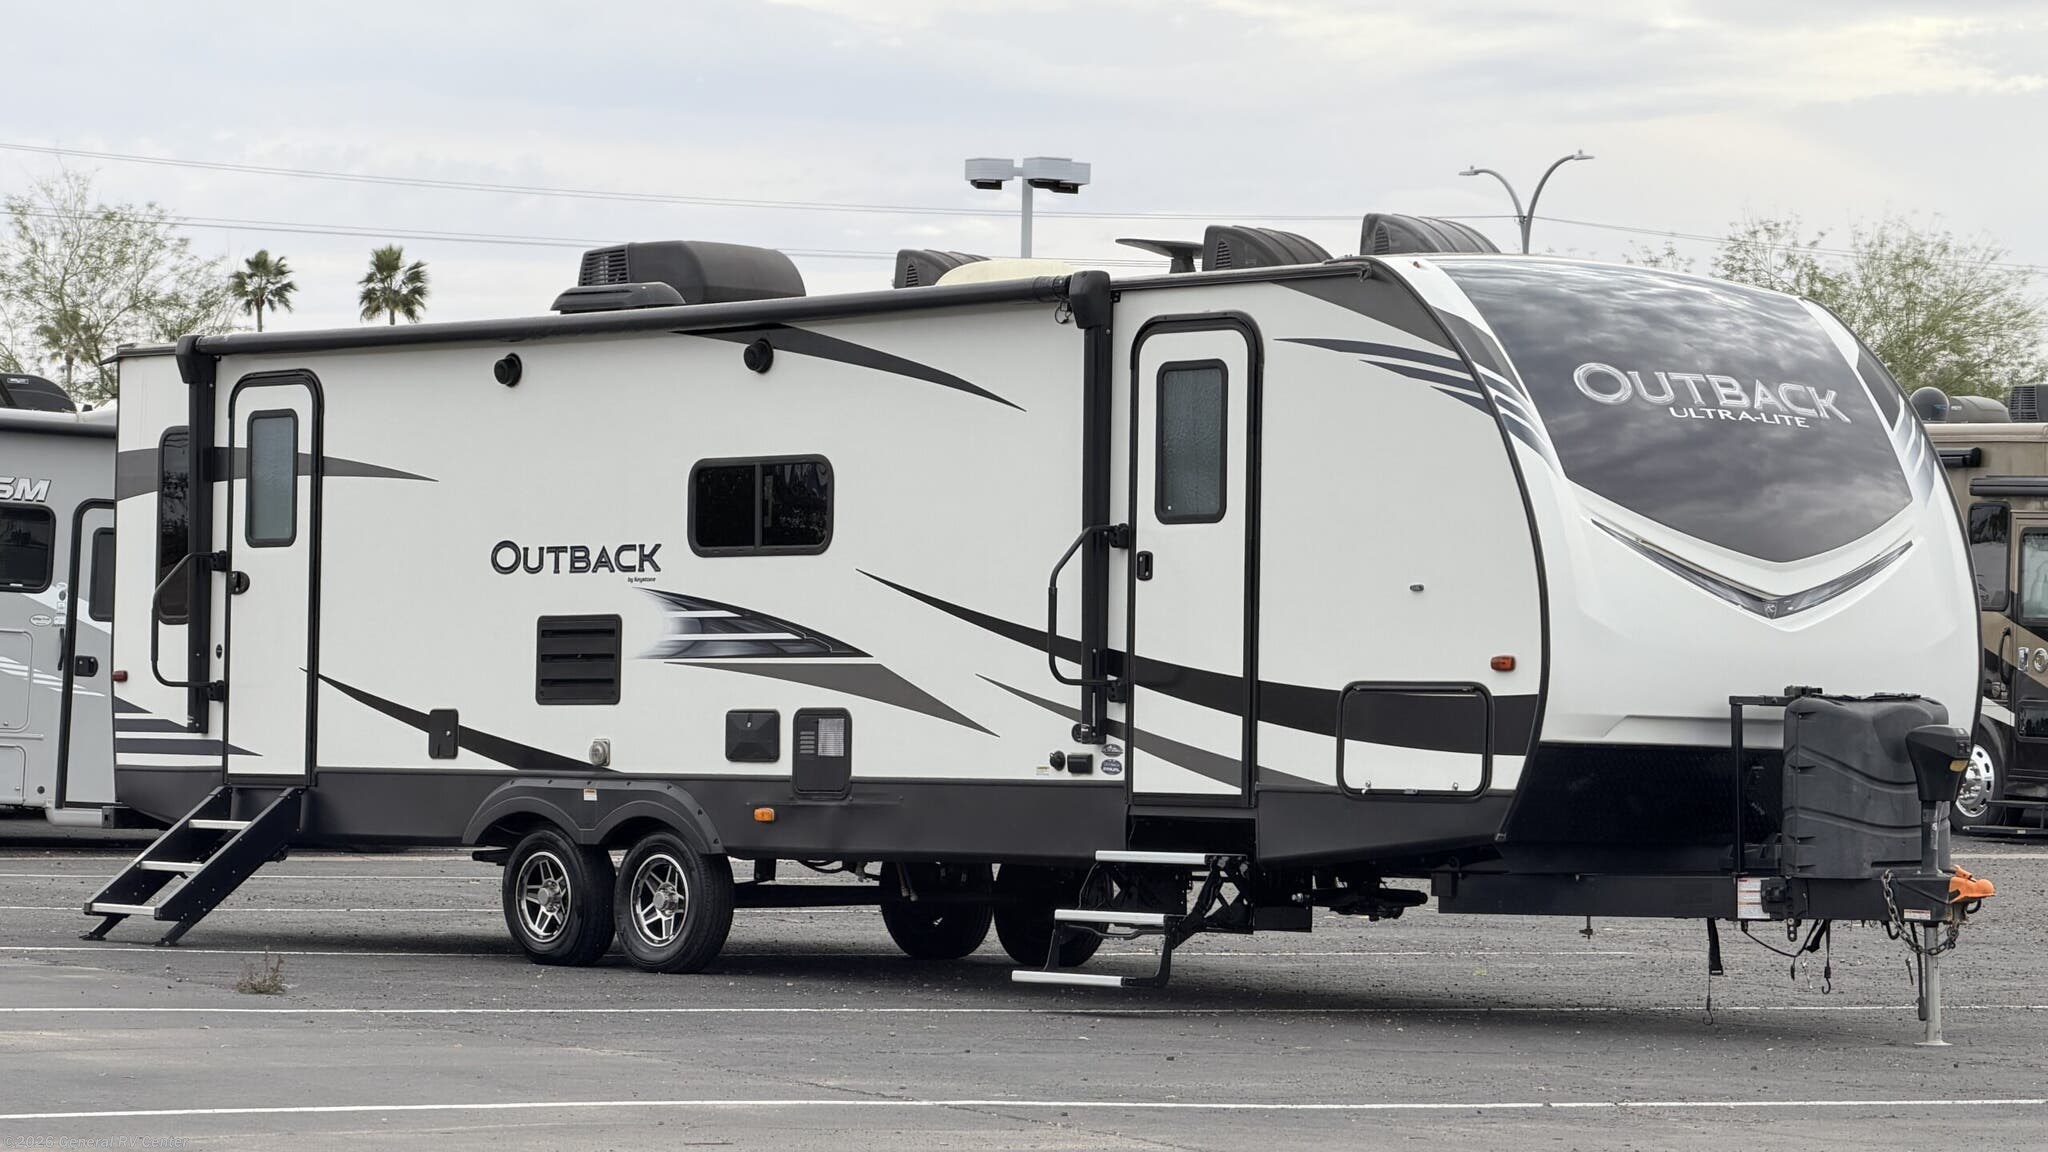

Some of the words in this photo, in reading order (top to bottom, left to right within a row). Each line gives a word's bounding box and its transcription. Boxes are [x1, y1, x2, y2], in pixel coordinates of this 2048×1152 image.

[1573, 362, 1851, 423] OUTBACK
[1669, 407, 1810, 428] ULTRA-LITE
[490, 540, 662, 575] OUTBACK
